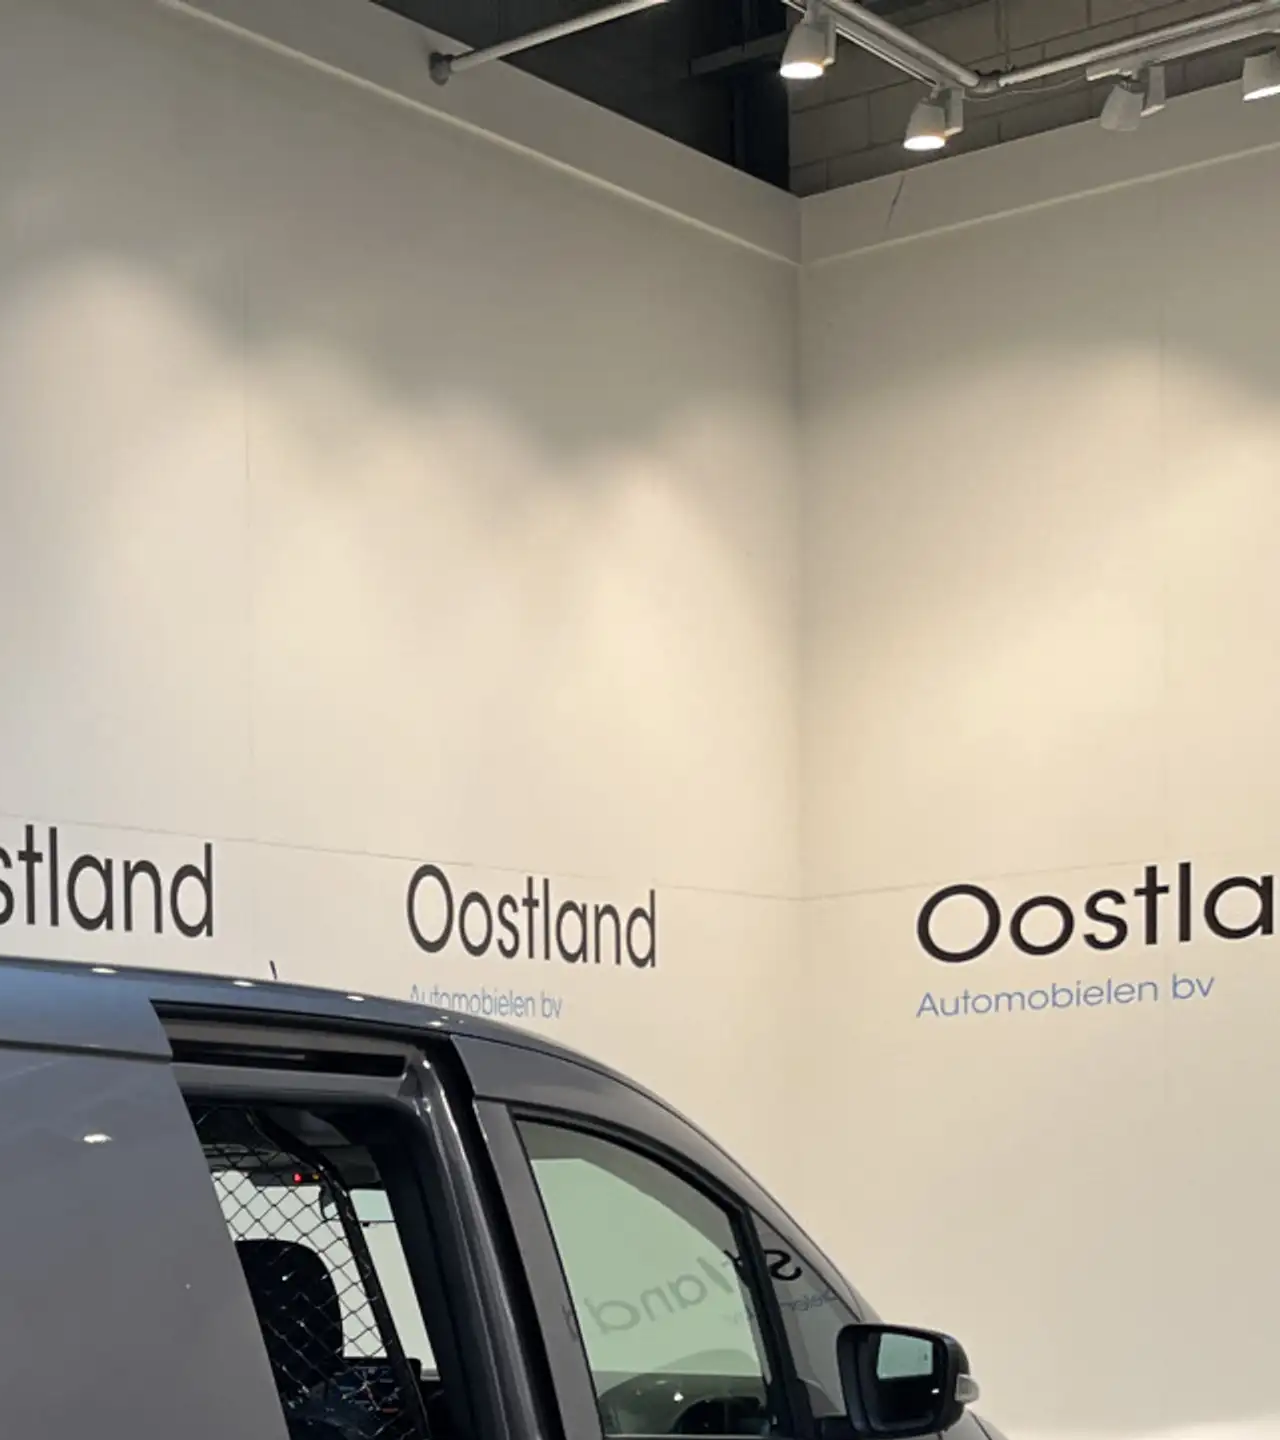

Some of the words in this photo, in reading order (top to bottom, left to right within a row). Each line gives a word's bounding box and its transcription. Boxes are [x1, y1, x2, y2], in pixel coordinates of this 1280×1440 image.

[406, 863, 656, 968] Oostland
[916, 861, 1274, 963] Oostla
[540, 988, 562, 1018] bv
[915, 978, 1158, 1019] Automobielen
[1171, 974, 1215, 1000] bv
